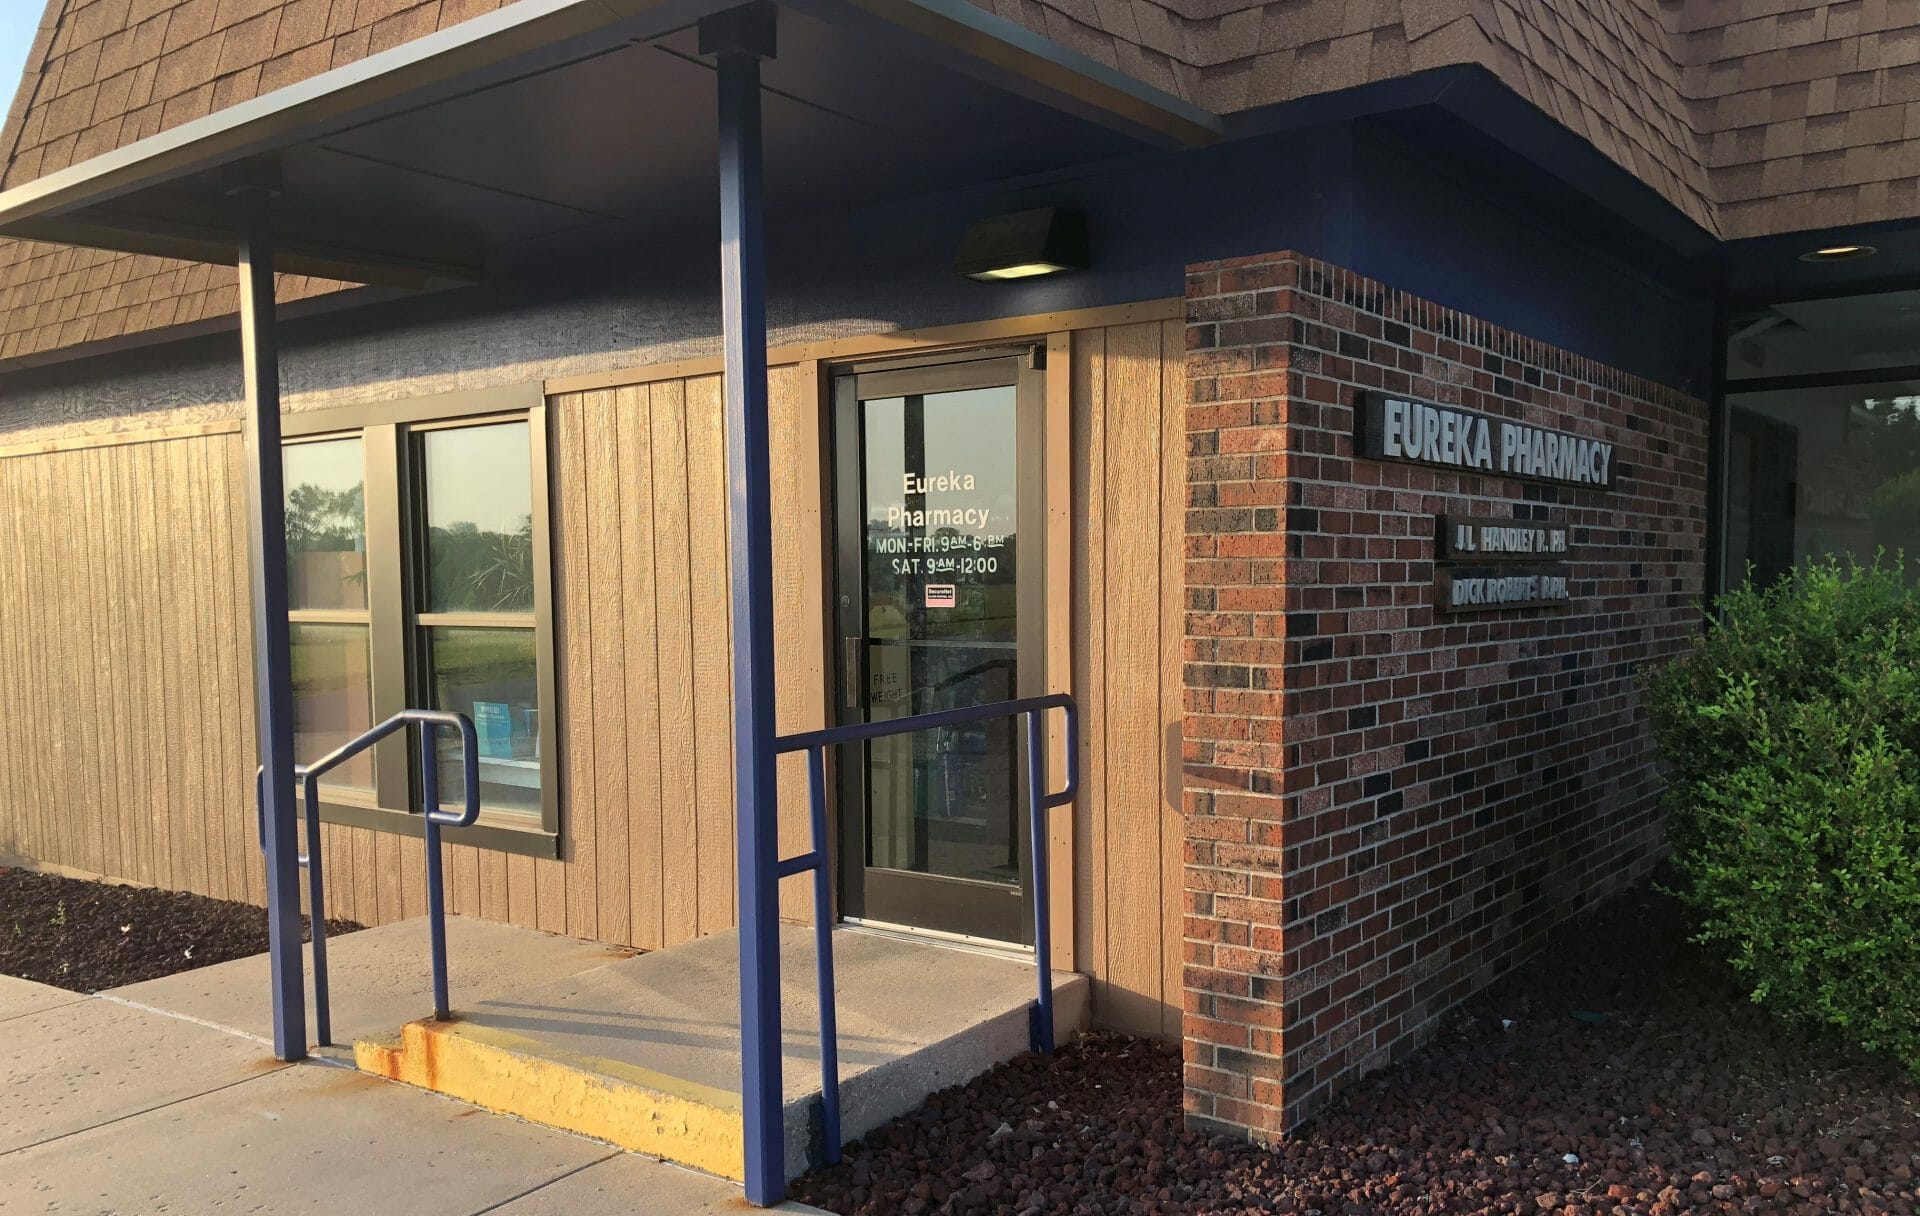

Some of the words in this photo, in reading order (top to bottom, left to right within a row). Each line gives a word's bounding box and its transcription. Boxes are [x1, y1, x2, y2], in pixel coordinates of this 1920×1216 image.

[1383, 399, 1493, 470] EUREKA
[1500, 422, 1612, 485] PHARMACY
[903, 470, 975, 494] Eureka
[887, 506, 990, 529] Pharmacy
[1480, 527, 1535, 552] HANDLEY
[891, 558, 924, 575] SAT.
[1451, 578, 1485, 606] DICK
[873, 672, 897, 686] FREE
[870, 687, 903, 703] WEIGHT
